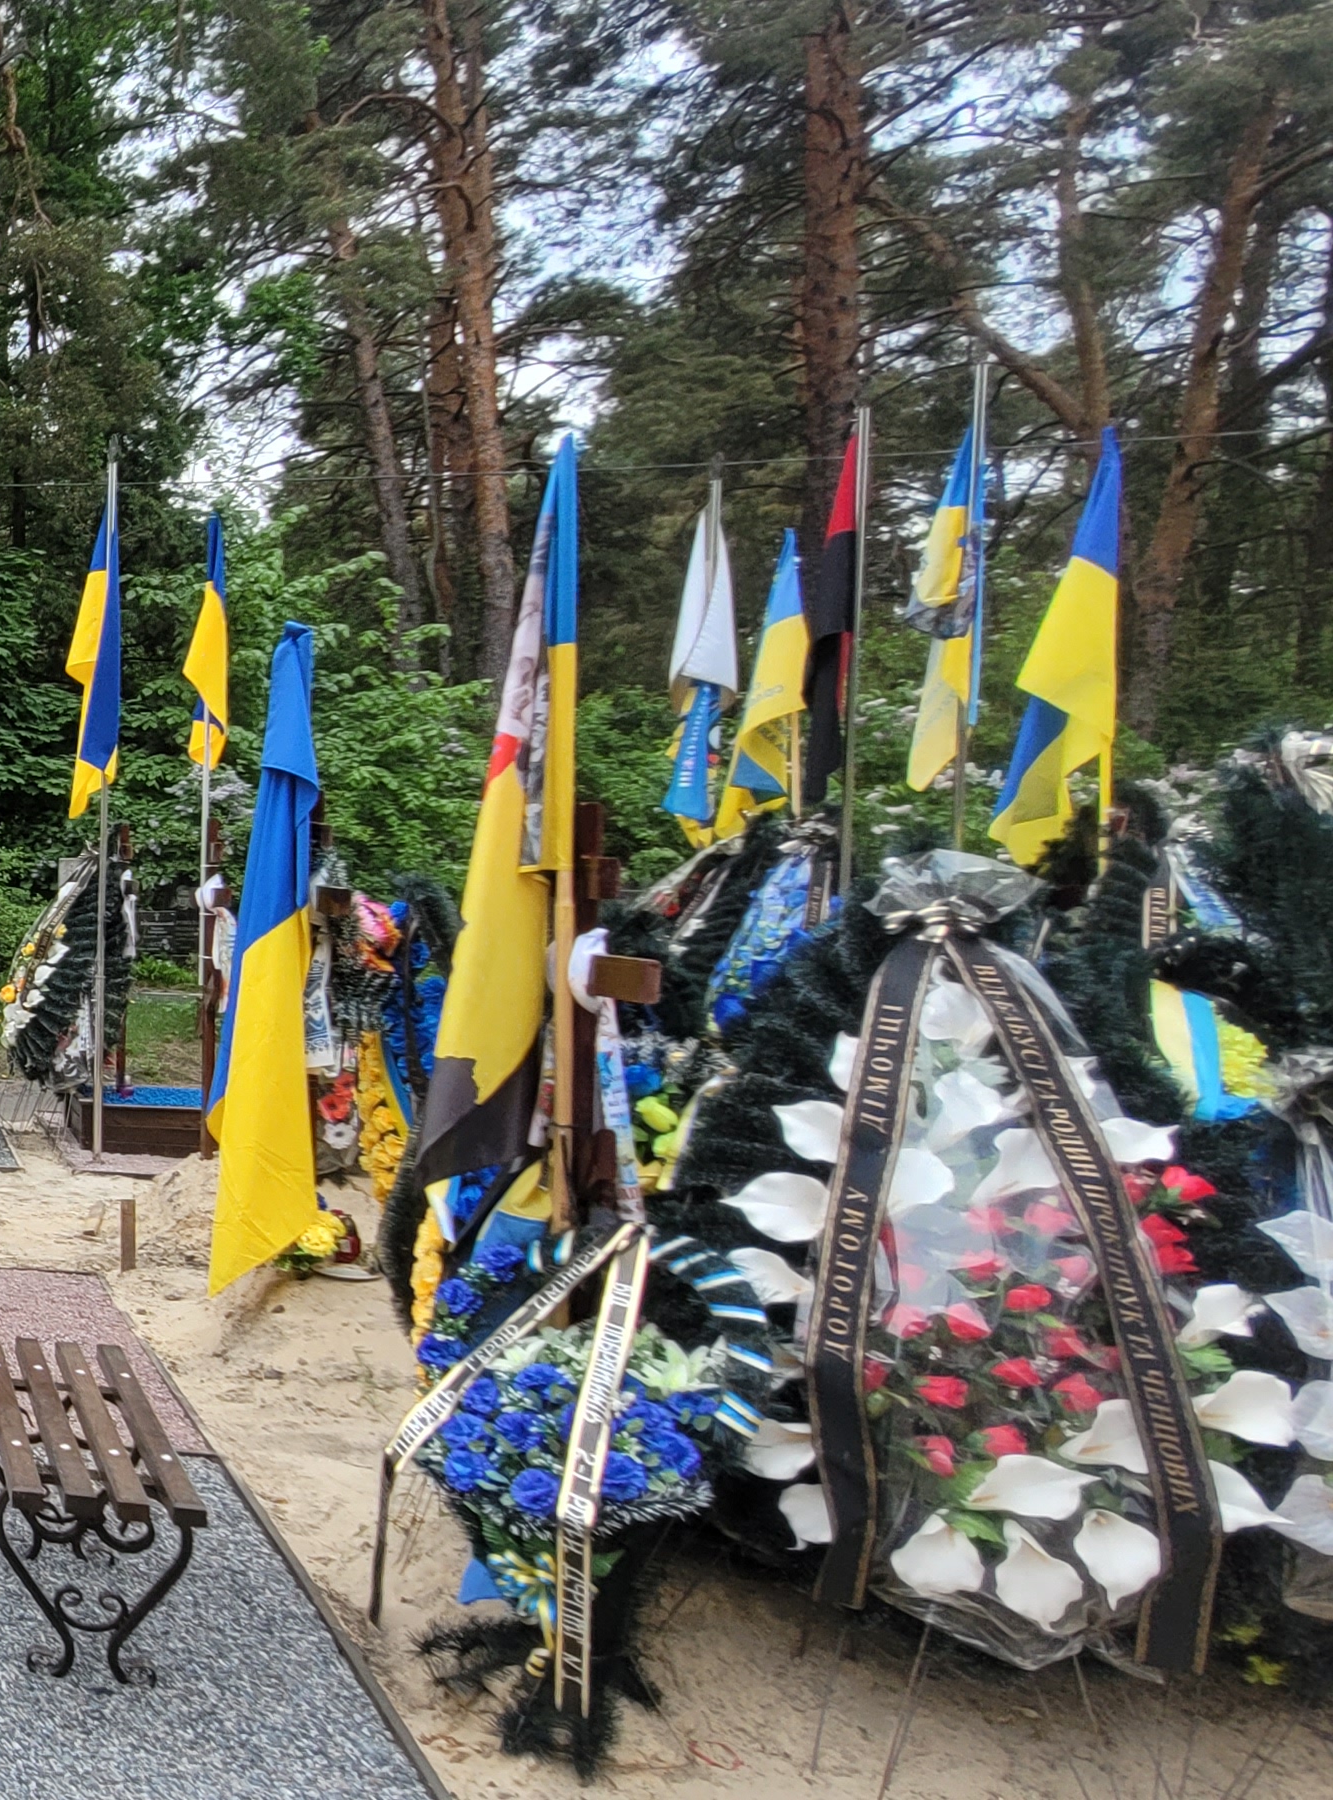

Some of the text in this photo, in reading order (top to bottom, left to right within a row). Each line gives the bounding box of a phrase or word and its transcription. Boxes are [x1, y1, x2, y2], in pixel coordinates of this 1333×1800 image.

[970, 957, 1006, 1004] ВІД
[1030, 1071, 1059, 1105] ТА
[1042, 1099, 1099, 1185] РОДИН
[821, 1000, 905, 1362] ДОРОГОМУ ДІМОЧЦІ
[610, 1282, 631, 1308] ВІД
[466, 1324, 520, 1373] ГЕРОЮ
[1128, 1330, 1155, 1363] ТА
[1141, 1368, 1198, 1518] ЧЕНЦОВИХ
